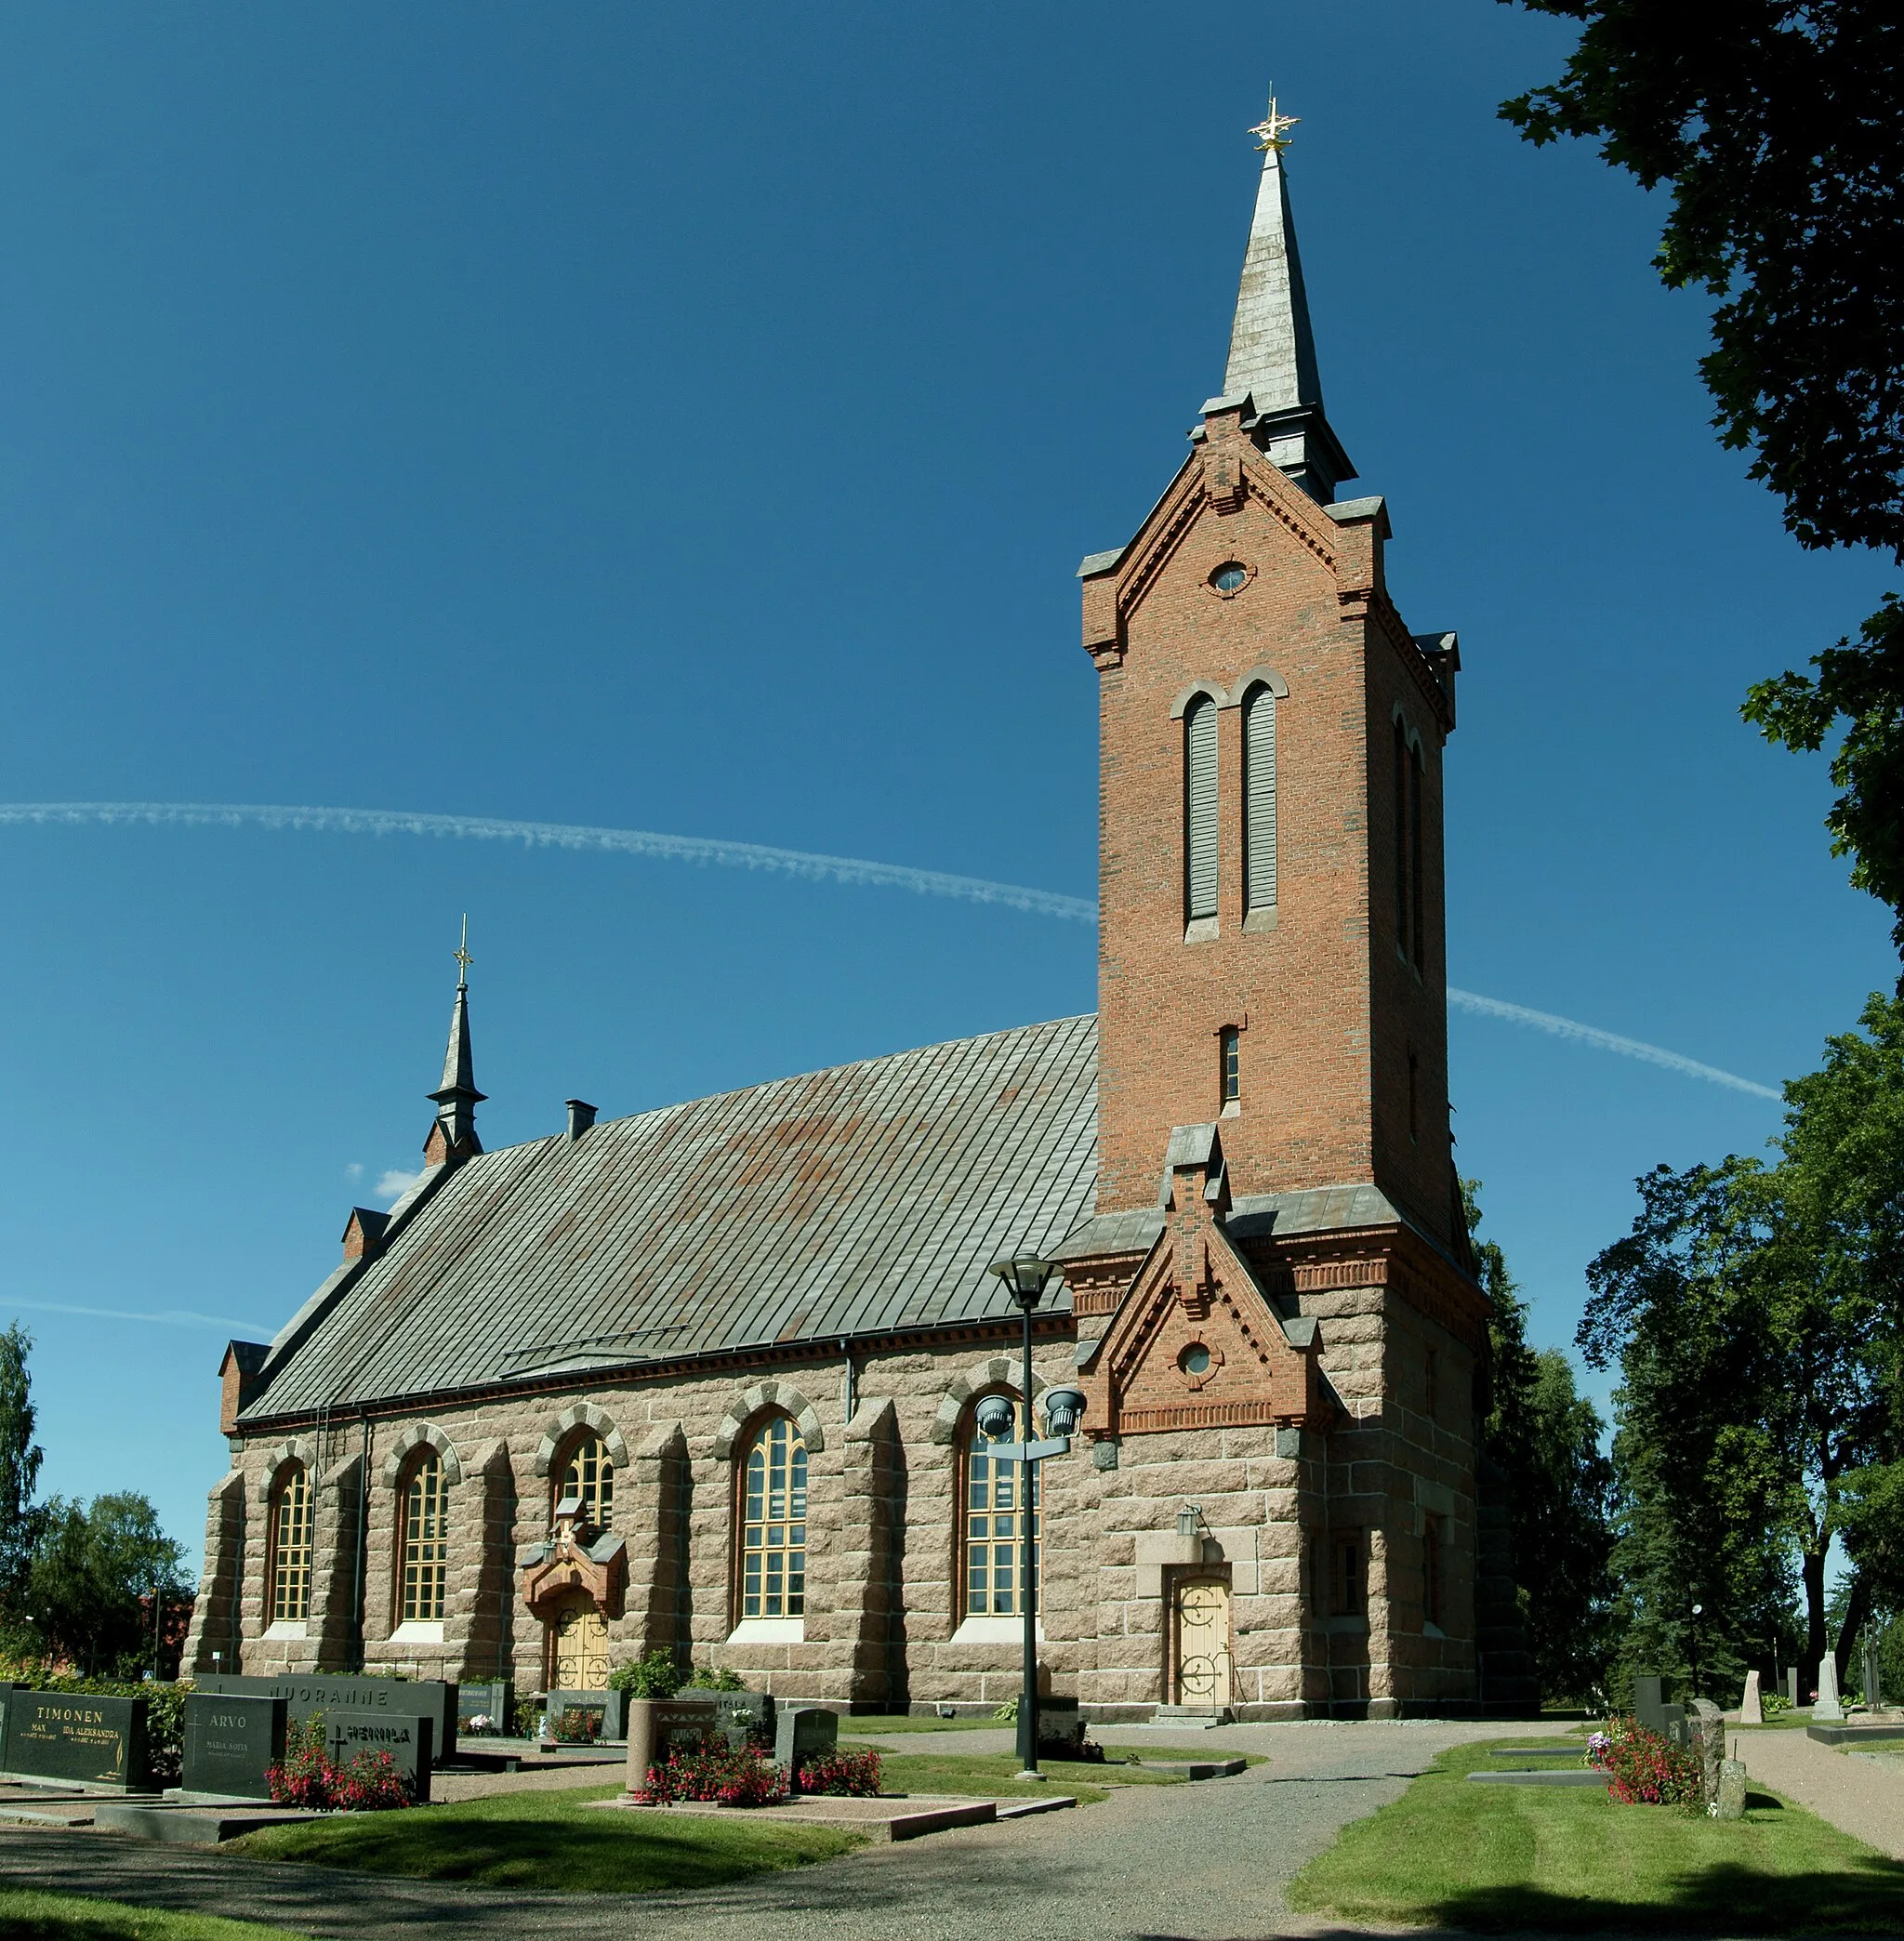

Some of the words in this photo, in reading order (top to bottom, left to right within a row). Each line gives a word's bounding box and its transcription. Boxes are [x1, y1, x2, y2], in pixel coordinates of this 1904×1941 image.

[270, 1684, 388, 1706] NUORANNE
[37, 1707, 102, 1723] TIMONEN
[209, 1714, 246, 1728] ARVO
[32, 1723, 46, 1732] MAX
[62, 1725, 73, 1735] IDA
[75, 1727, 119, 1739] ALEKSANDRA
